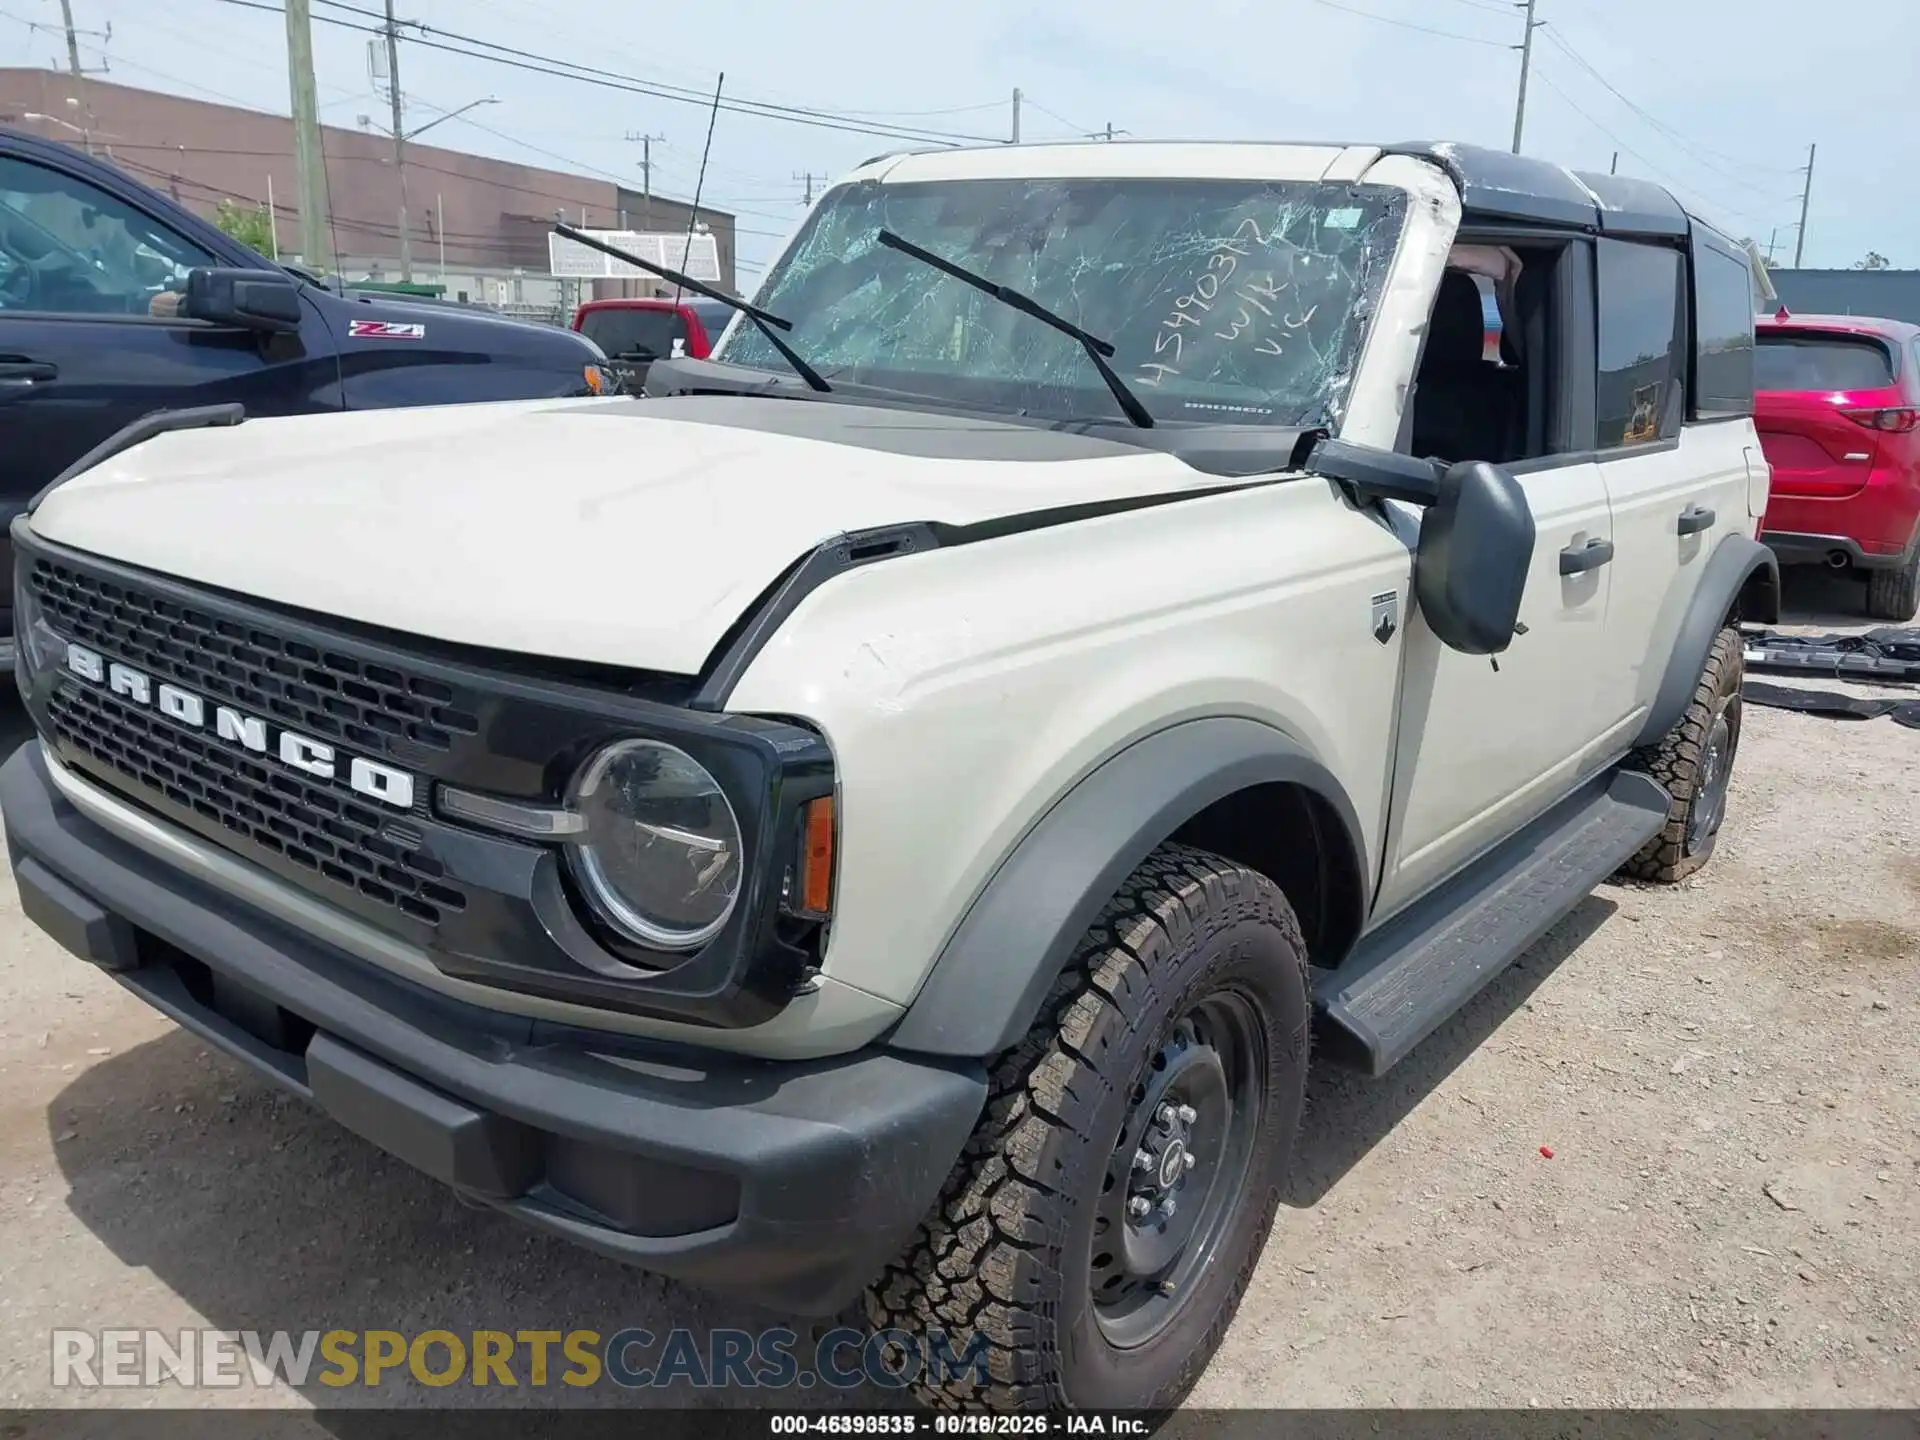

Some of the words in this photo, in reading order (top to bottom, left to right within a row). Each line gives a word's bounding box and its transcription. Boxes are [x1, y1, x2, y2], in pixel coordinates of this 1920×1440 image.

[348, 319, 425, 339] Z71
[1184, 402, 1273, 415] BRONCO
[67, 643, 414, 808] BRONCO
